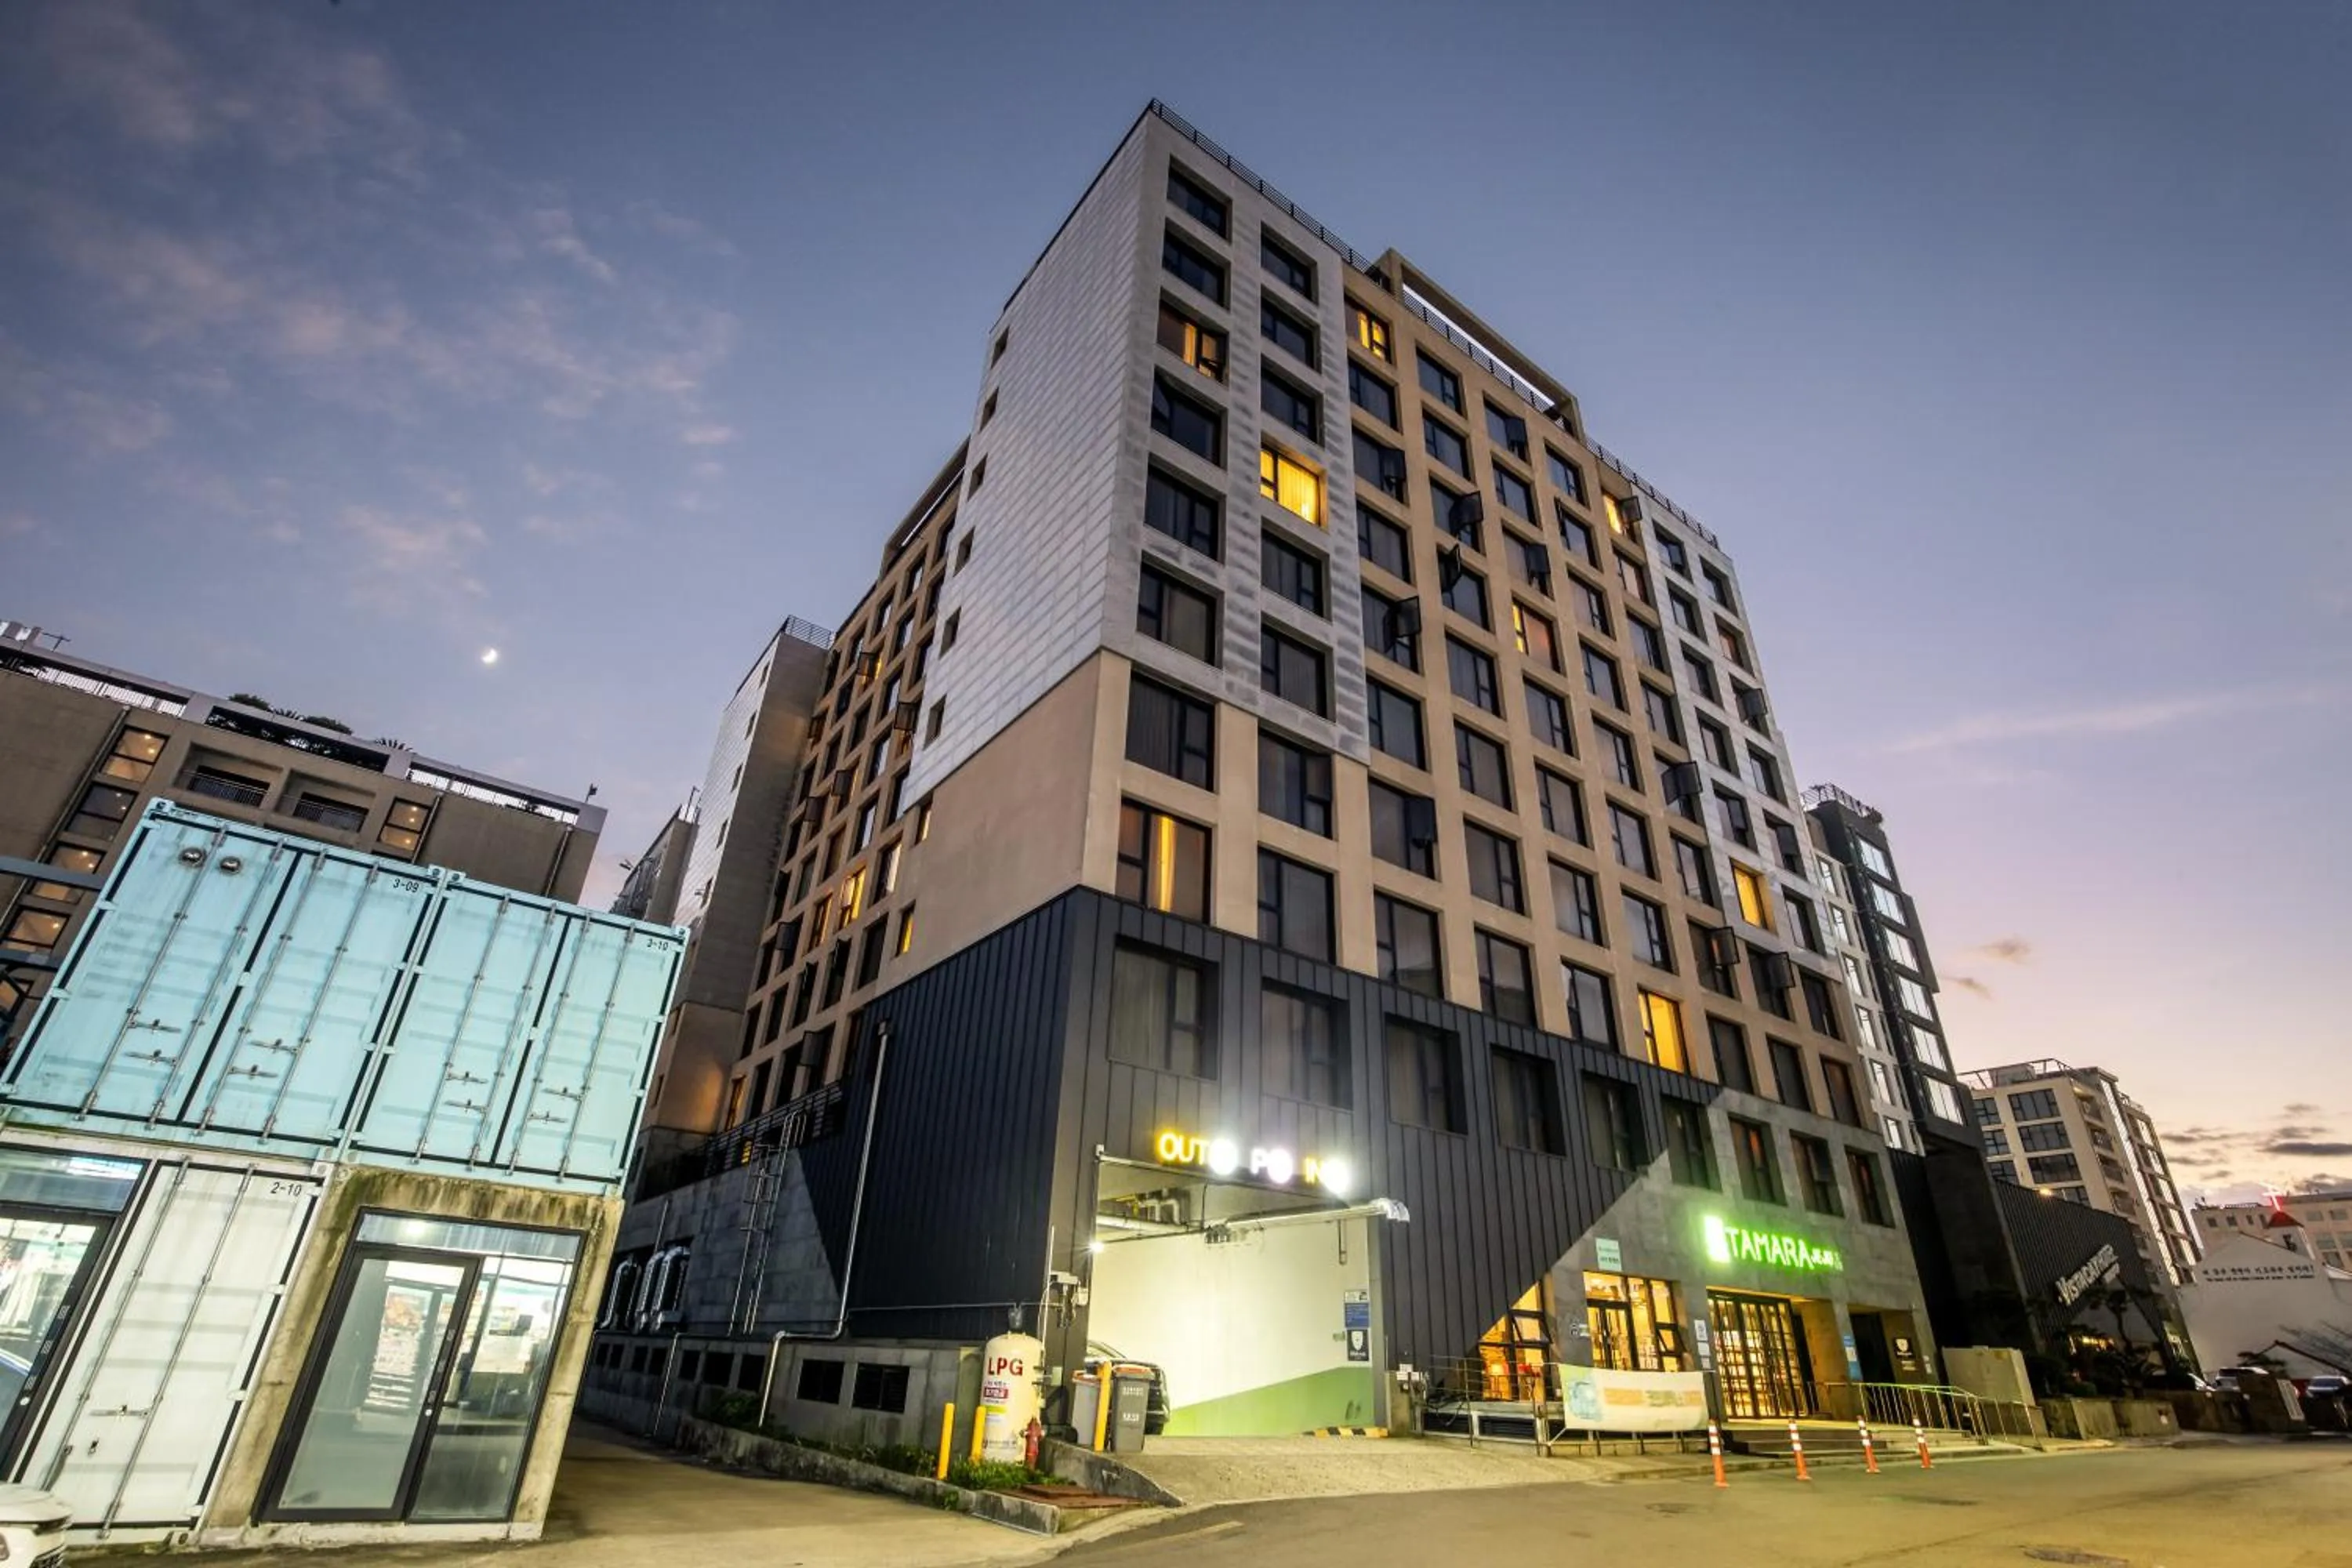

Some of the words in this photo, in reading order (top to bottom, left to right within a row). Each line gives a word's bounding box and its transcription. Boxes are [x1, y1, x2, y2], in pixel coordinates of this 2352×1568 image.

[394, 877, 419, 893] 3-09
[1159, 1131, 1211, 1167] OUT
[270, 1181, 303, 1197] 2-10
[1724, 1225, 1815, 1271] TAMARA
[989, 1357, 1023, 1376] LPG
